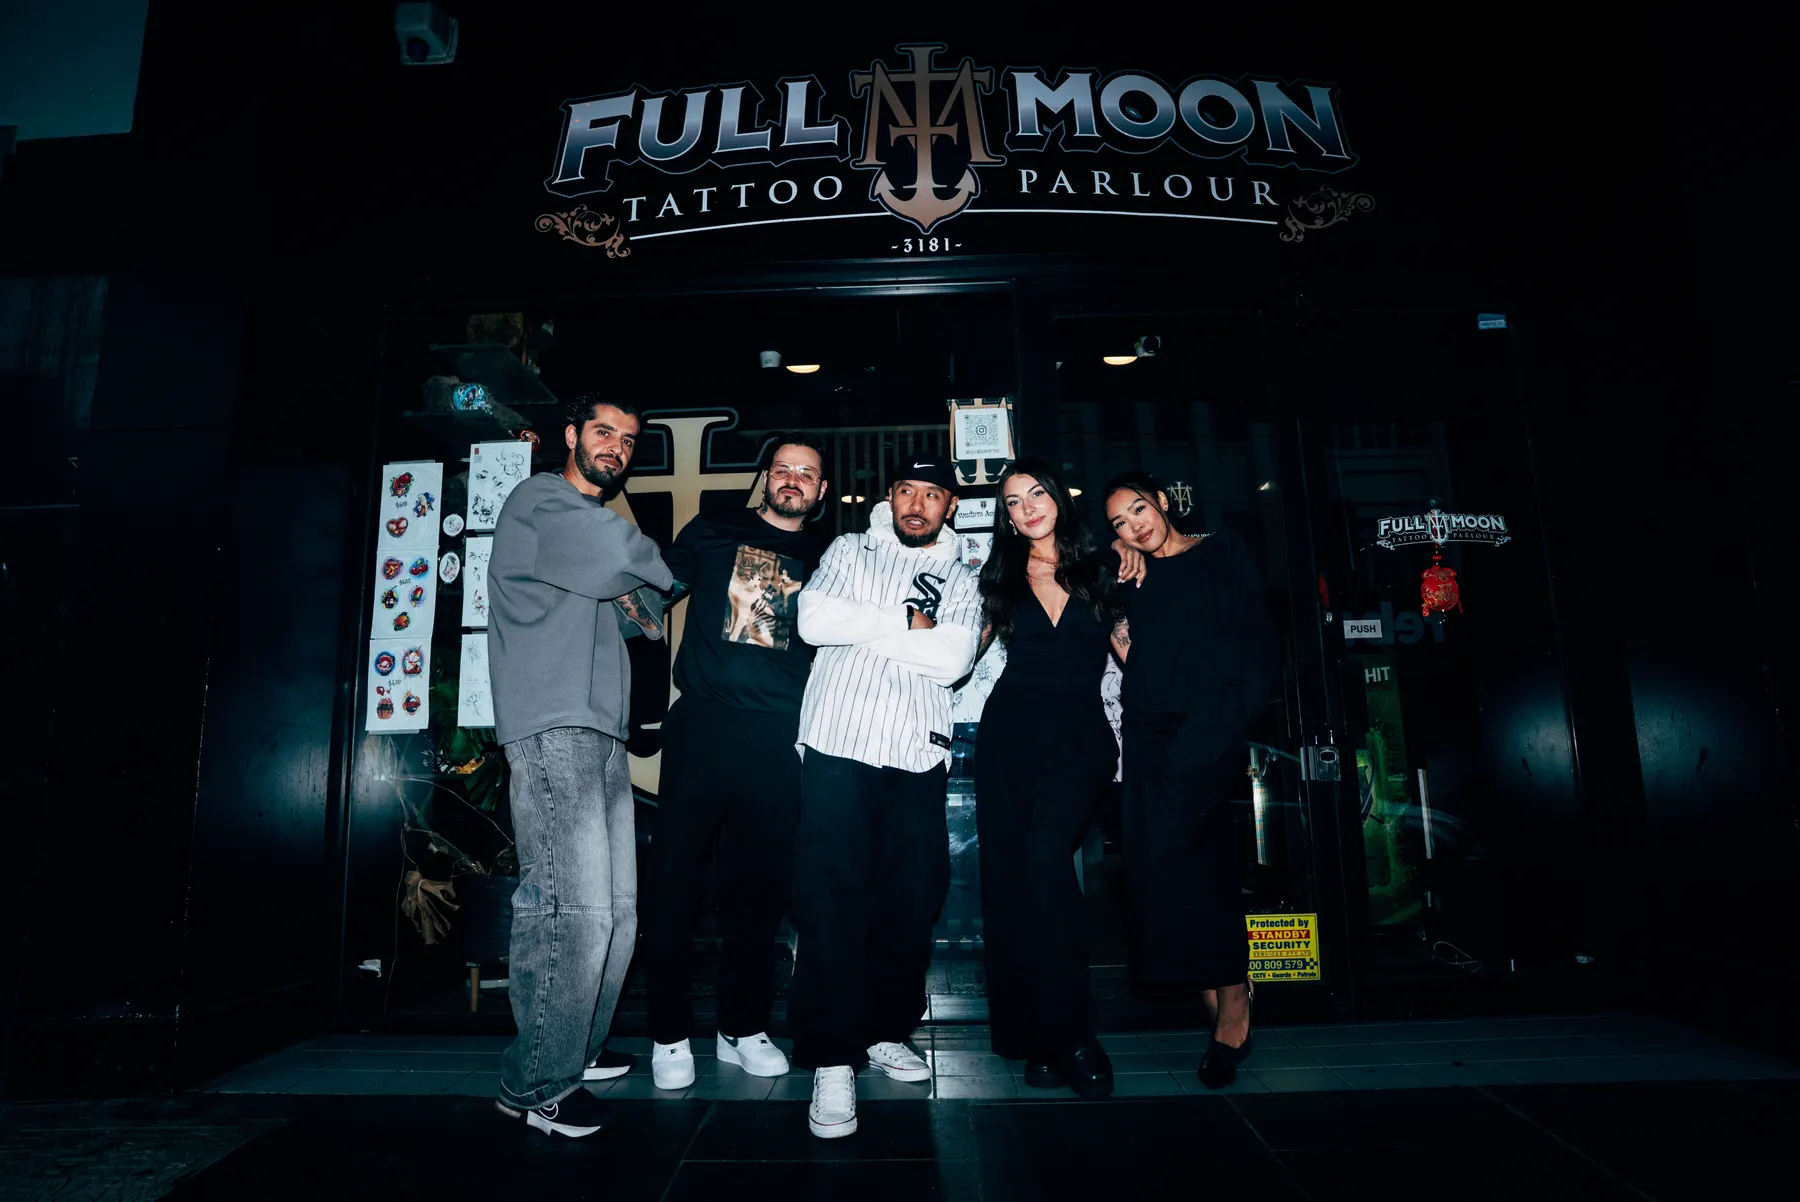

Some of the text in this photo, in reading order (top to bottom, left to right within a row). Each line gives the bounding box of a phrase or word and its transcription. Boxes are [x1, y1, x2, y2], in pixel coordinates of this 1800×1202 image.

[550, 71, 1352, 186] FULL MOON
[622, 168, 1280, 223] TATTOO PARLOUR
[1379, 515, 1506, 537] FULL MOON
[1391, 532, 1495, 543] TATTOO PARLOUR
[1350, 624, 1377, 634] PUSH
[1364, 665, 1391, 684] HIT
[1250, 918, 1309, 928] Protected by
[1252, 930, 1307, 939] STANDBY
[1253, 941, 1310, 950] SECURITY
[1249, 959, 1304, 970] 00 809 579
